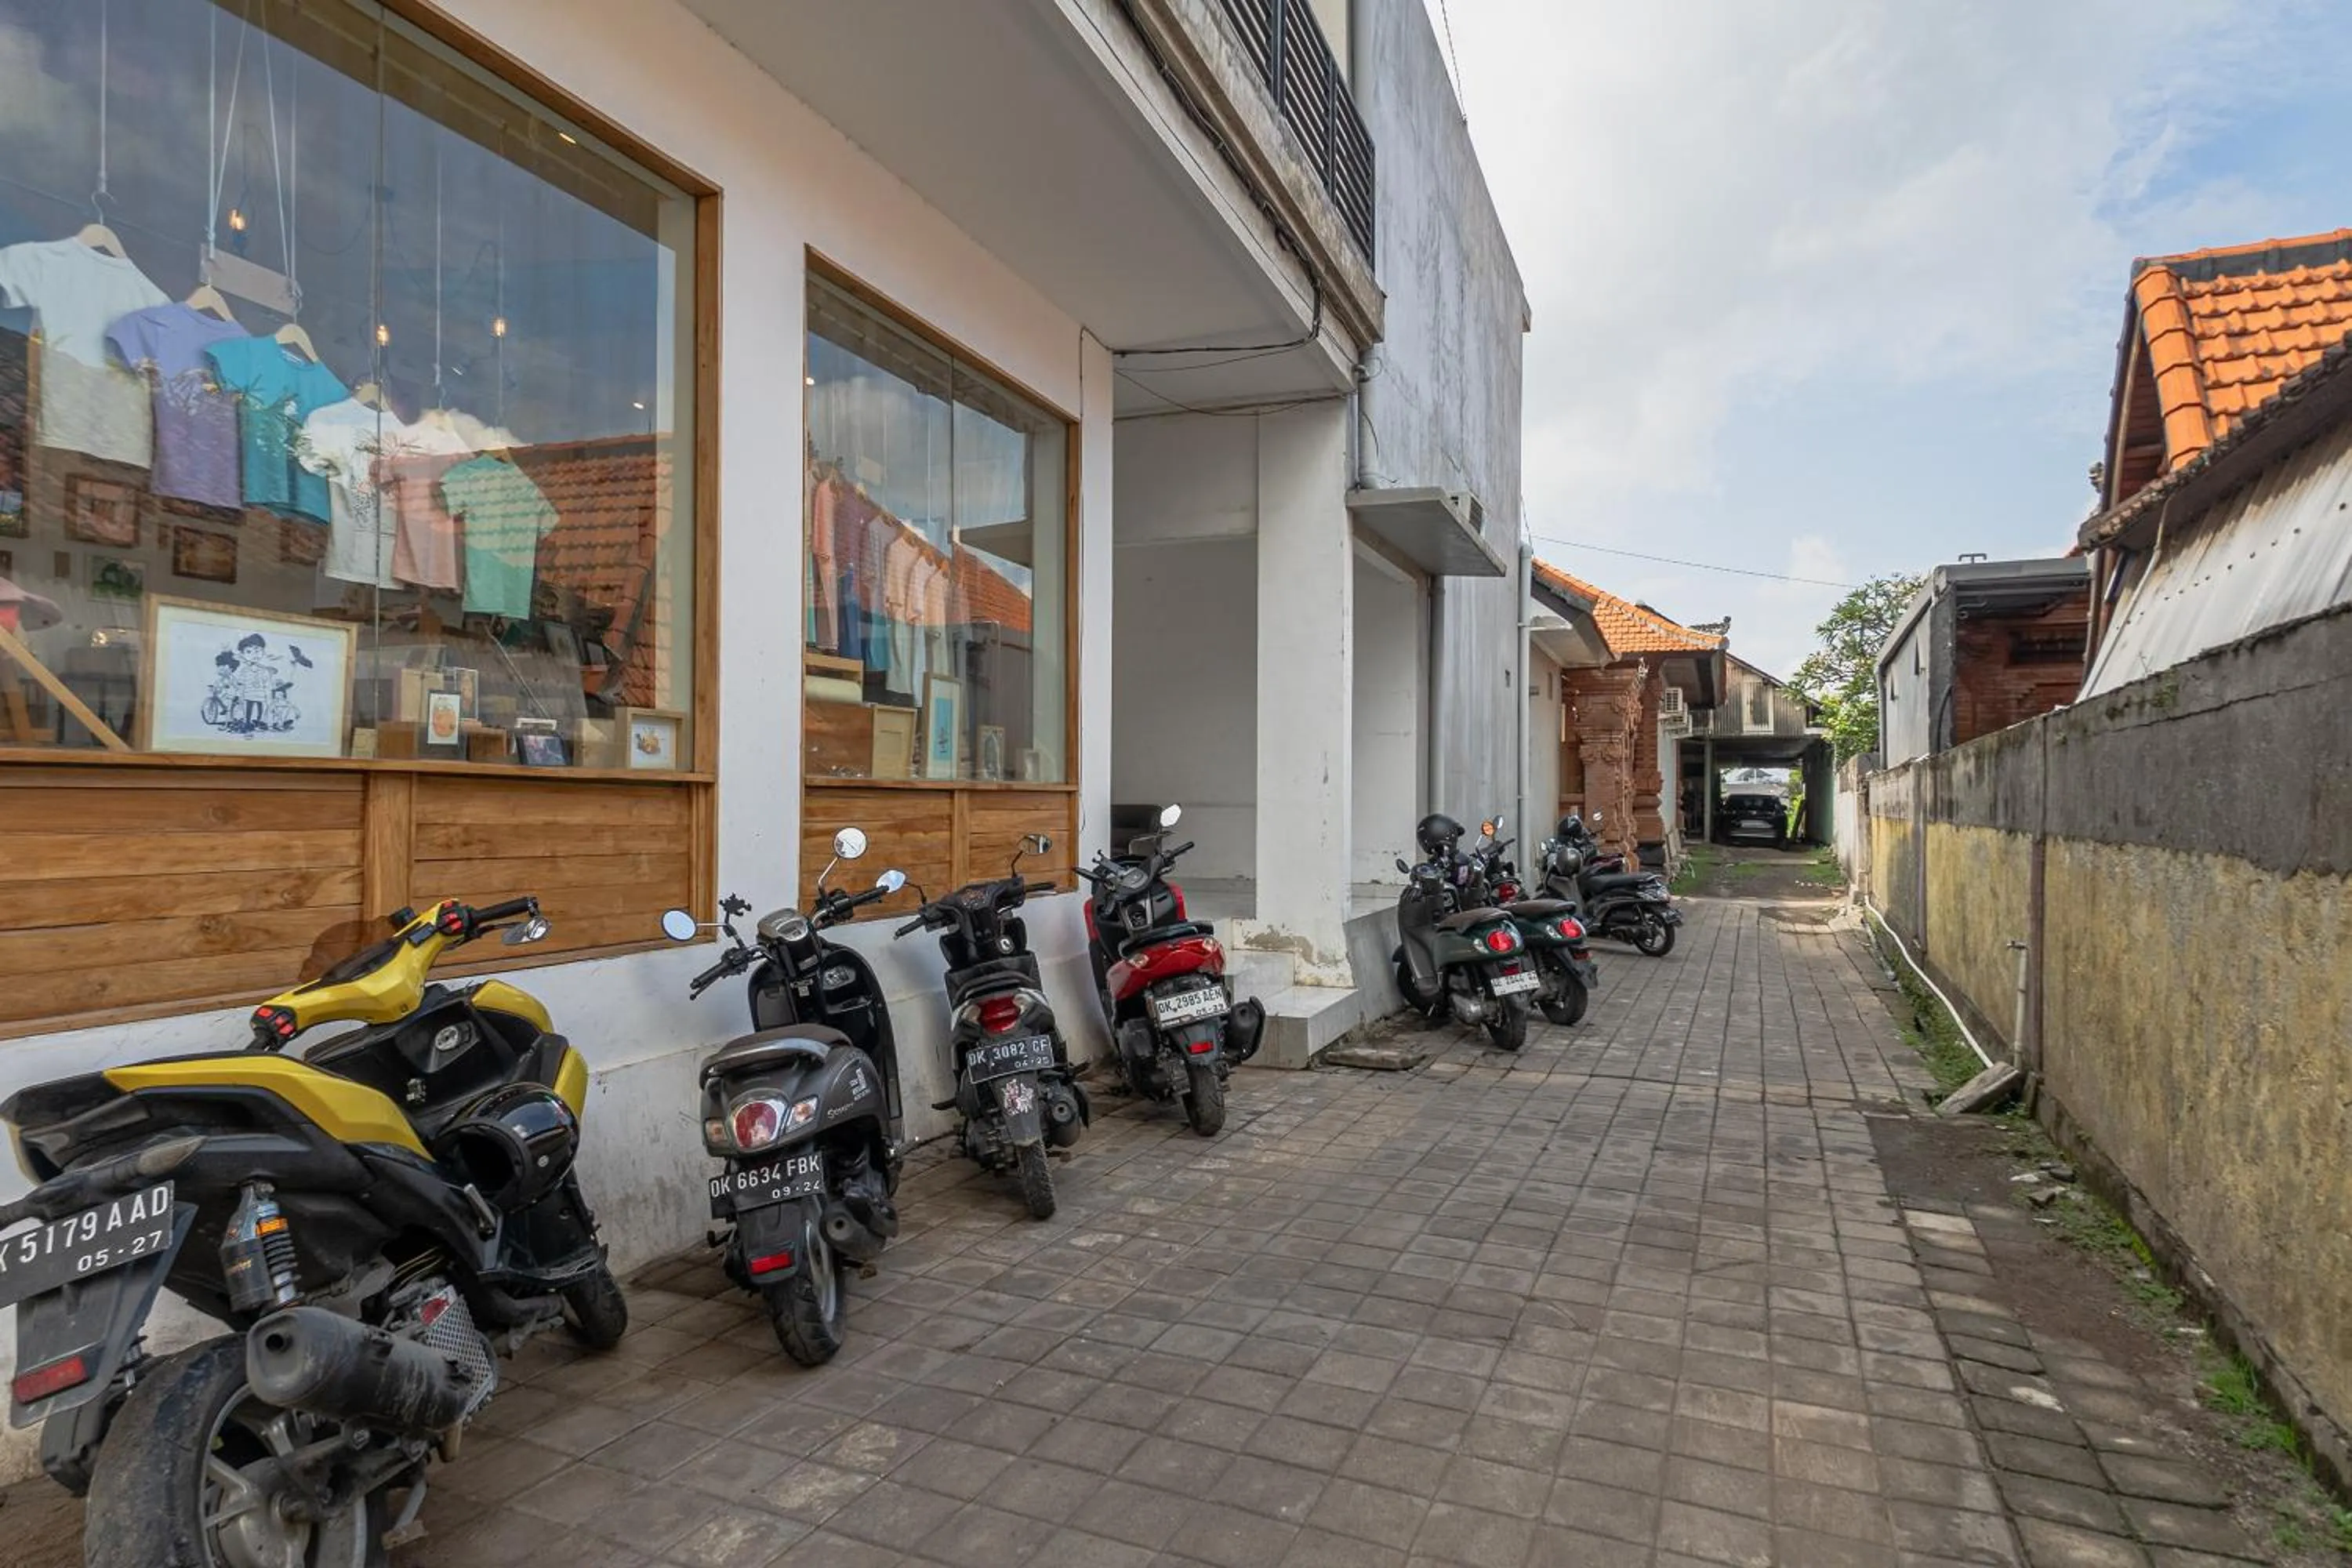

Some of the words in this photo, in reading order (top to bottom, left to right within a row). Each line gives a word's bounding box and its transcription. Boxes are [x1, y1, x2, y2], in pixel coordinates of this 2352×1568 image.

[968, 1051, 985, 1066] DK
[993, 1042, 1026, 1060] 3082
[710, 1177, 731, 1197] DK
[738, 1163, 781, 1189] 6634
[786, 1155, 820, 1177] FBK
[20, 1212, 98, 1263] 5179
[107, 1186, 169, 1232] AAD
